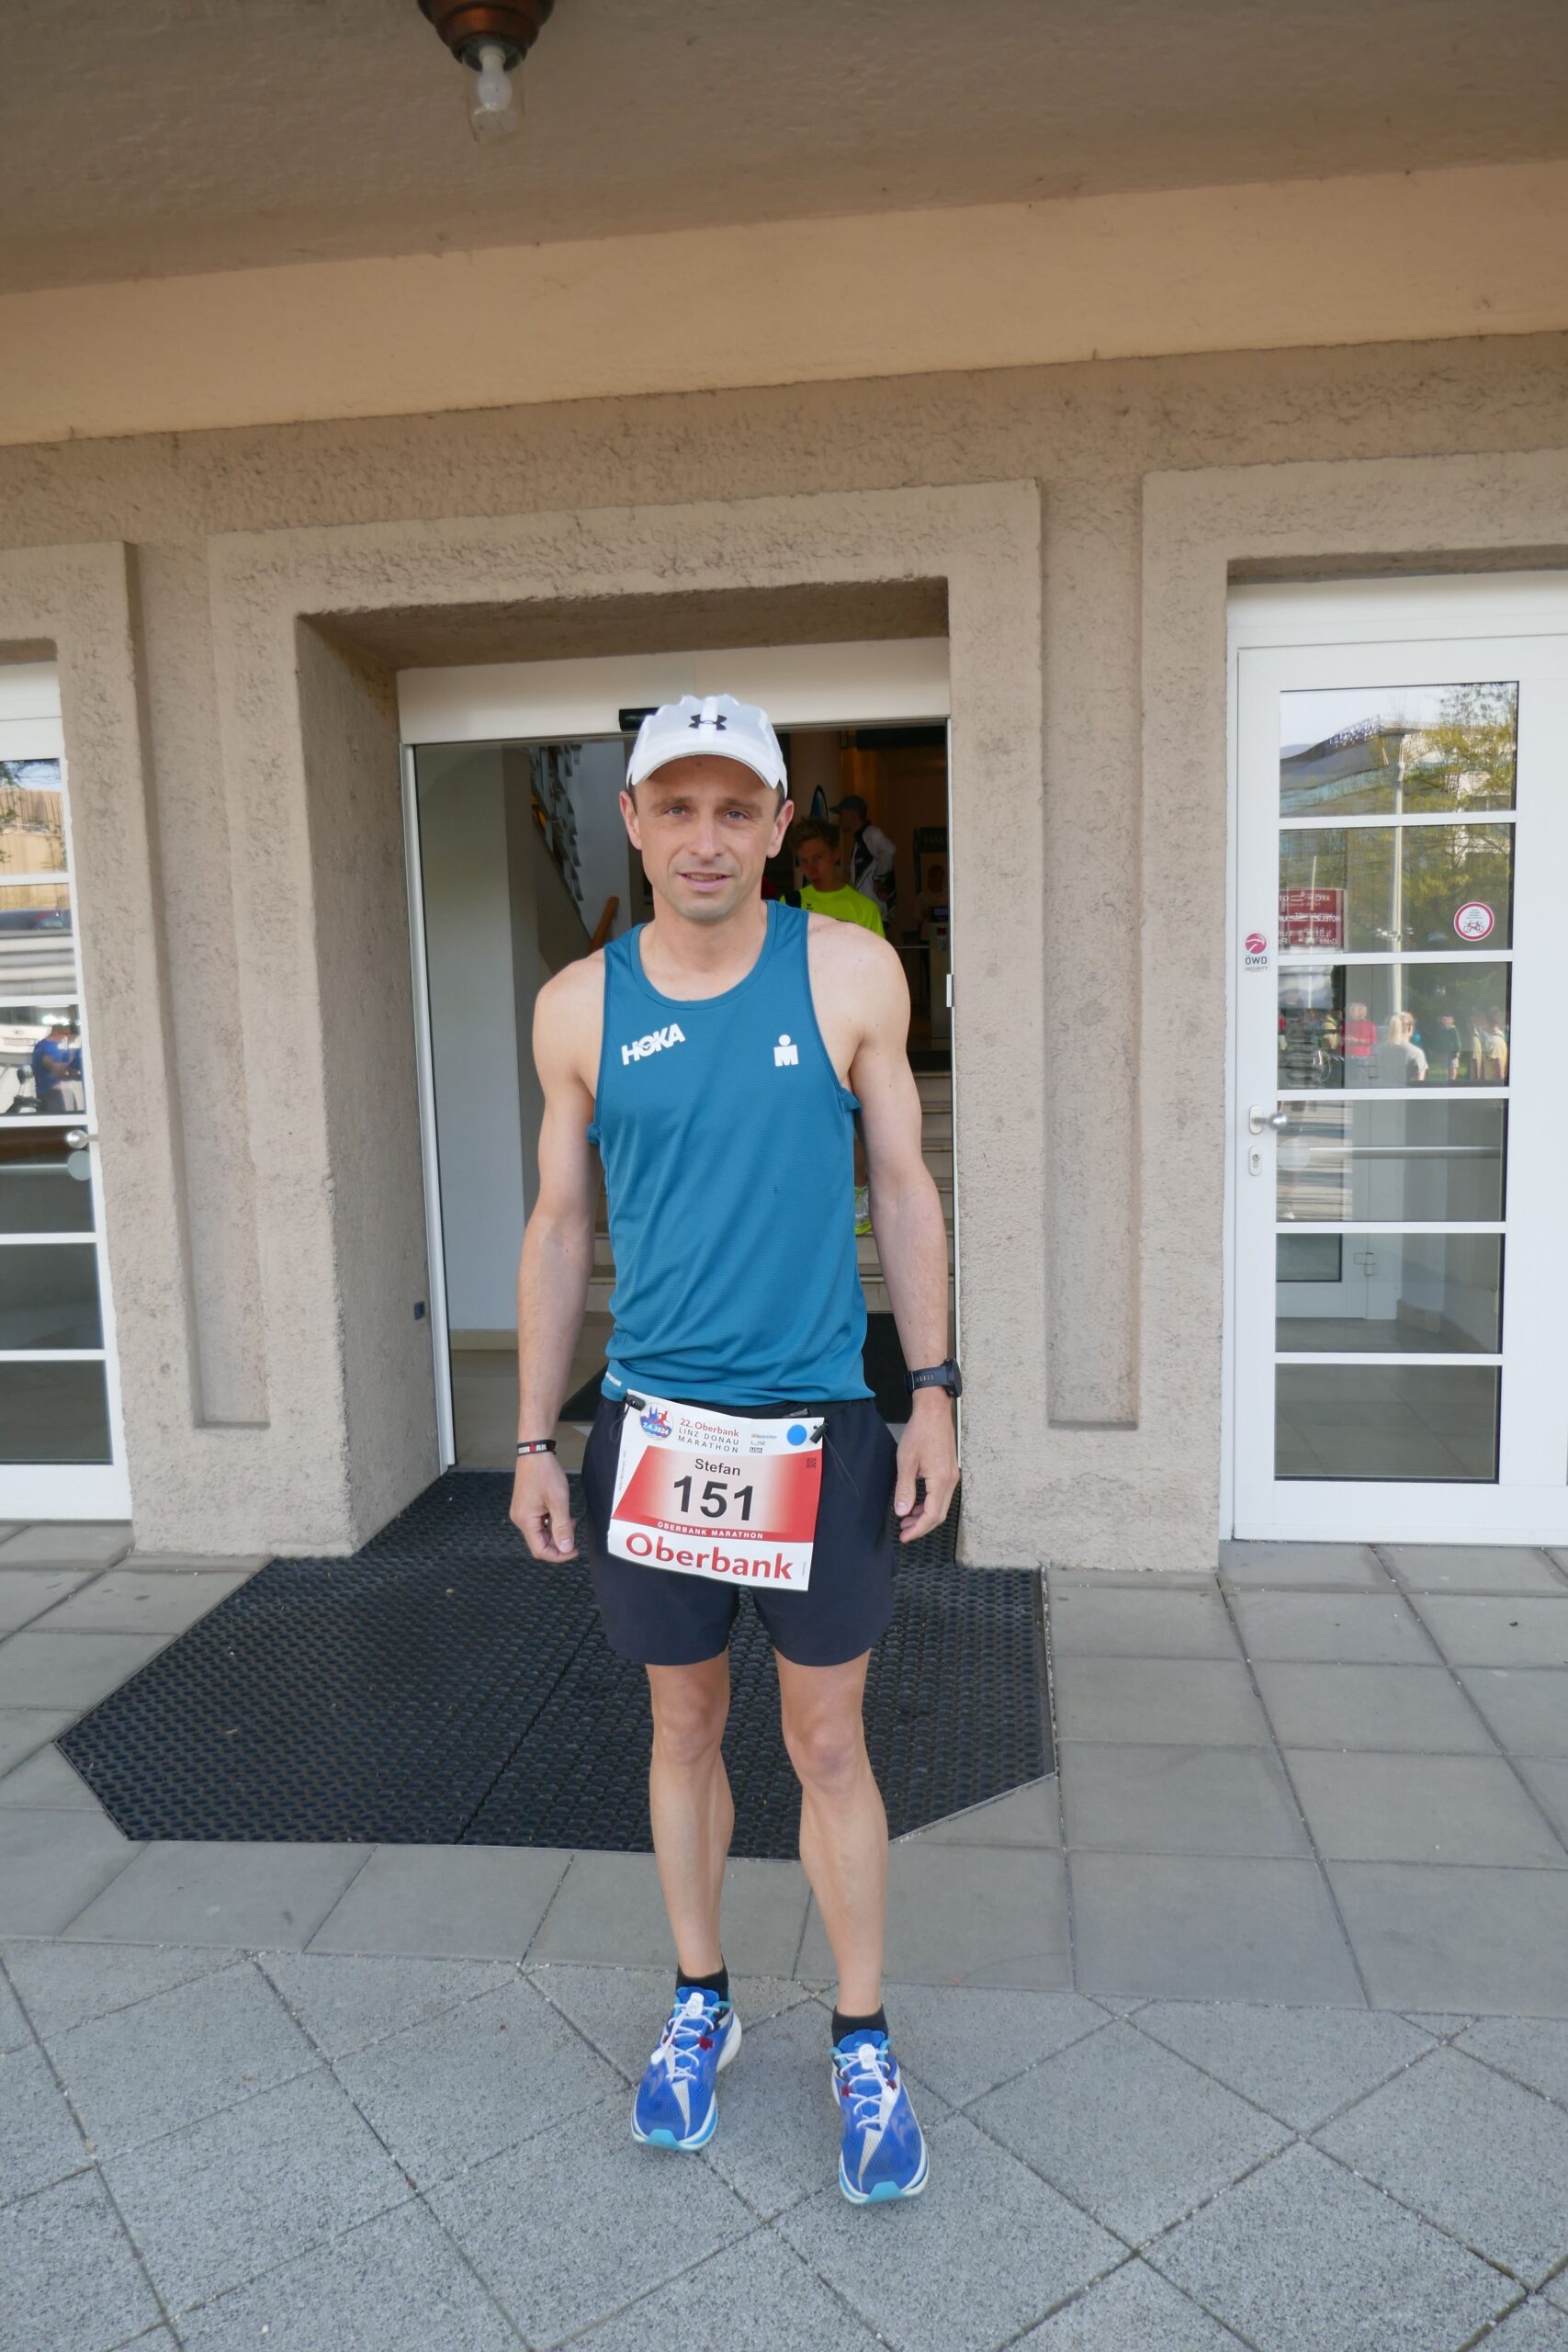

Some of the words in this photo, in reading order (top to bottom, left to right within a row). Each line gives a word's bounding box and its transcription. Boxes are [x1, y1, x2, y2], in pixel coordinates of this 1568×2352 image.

[1245, 955, 1268, 965] ÖWD
[621, 1023, 685, 1066] HOKA
[679, 1427, 699, 1438] LINZ
[704, 1432, 739, 1445] DONAU
[680, 1418, 693, 1428] 22.
[694, 1421, 739, 1438] Oberbank
[678, 1434, 739, 1453] MARATHON
[694, 1458, 741, 1476] Stefan
[673, 1475, 753, 1521] 151
[658, 1521, 707, 1536] OBERBANK
[711, 1529, 764, 1540] MARATHON
[626, 1532, 794, 1580] Oberbank
